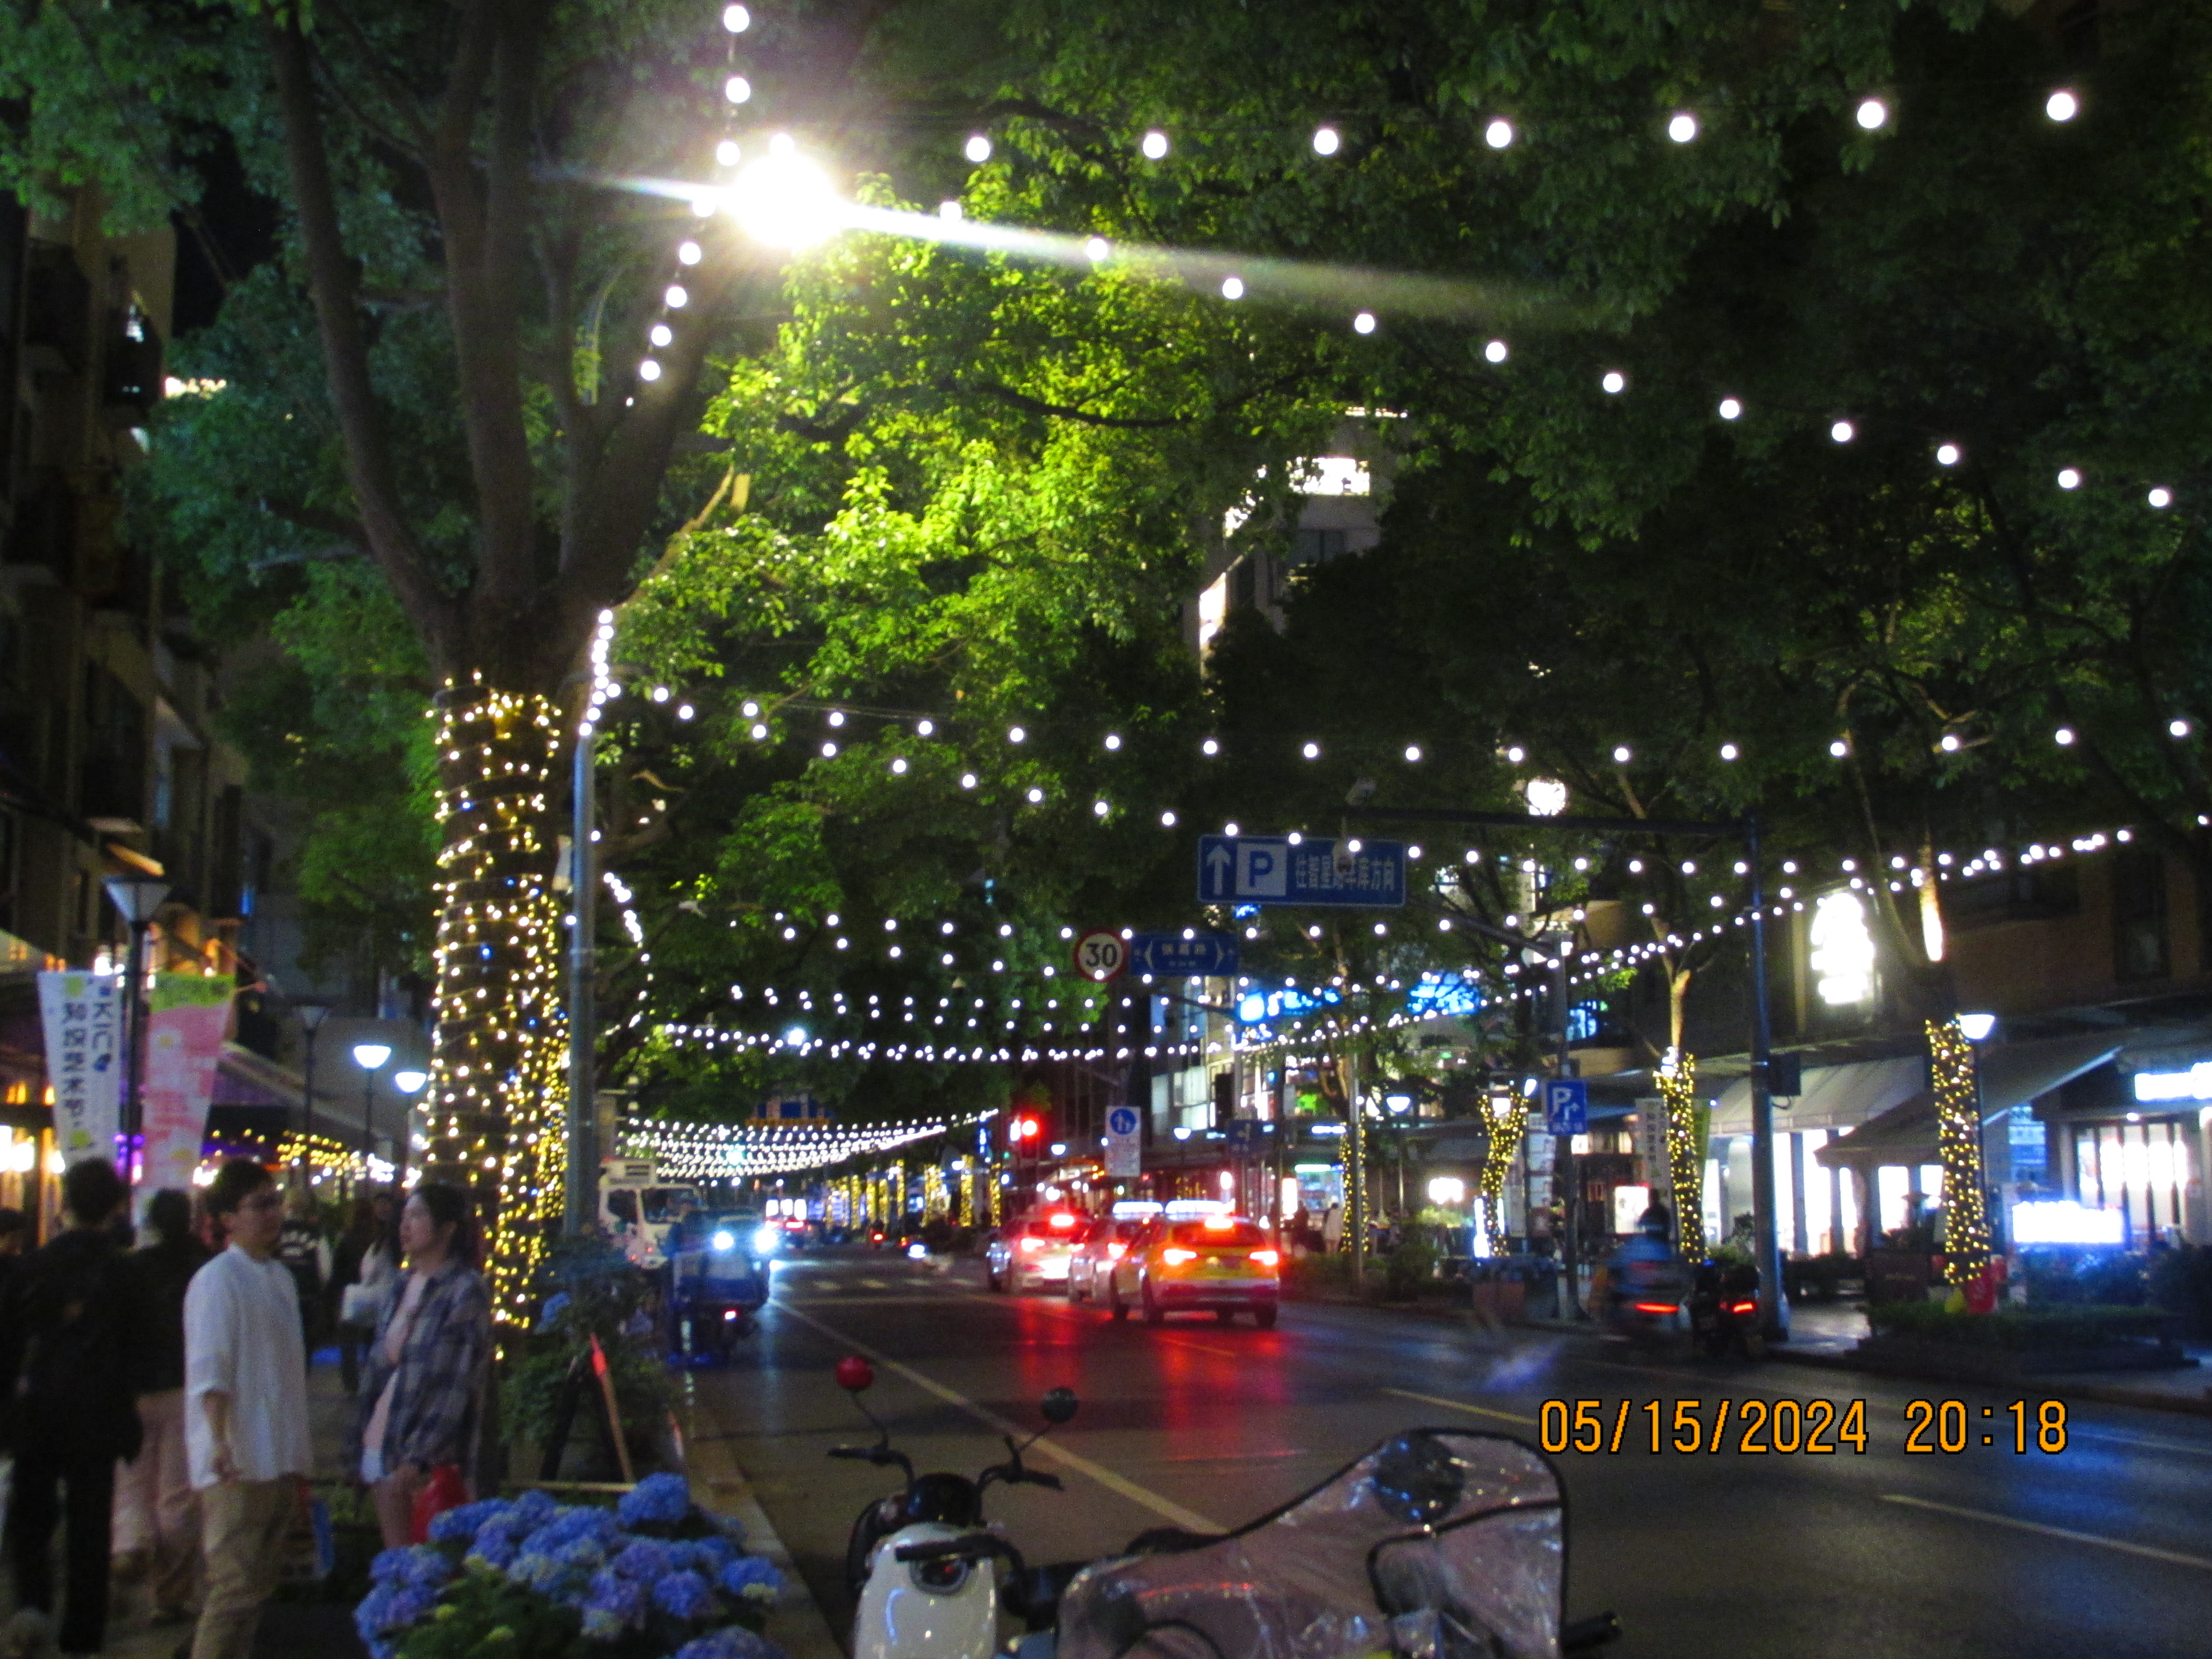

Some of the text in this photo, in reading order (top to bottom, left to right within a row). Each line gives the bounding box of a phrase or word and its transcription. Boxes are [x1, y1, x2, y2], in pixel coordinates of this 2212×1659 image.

[1249, 851, 1274, 888] P
[1085, 943, 1118, 968] 30
[1552, 1087, 1573, 1113] P
